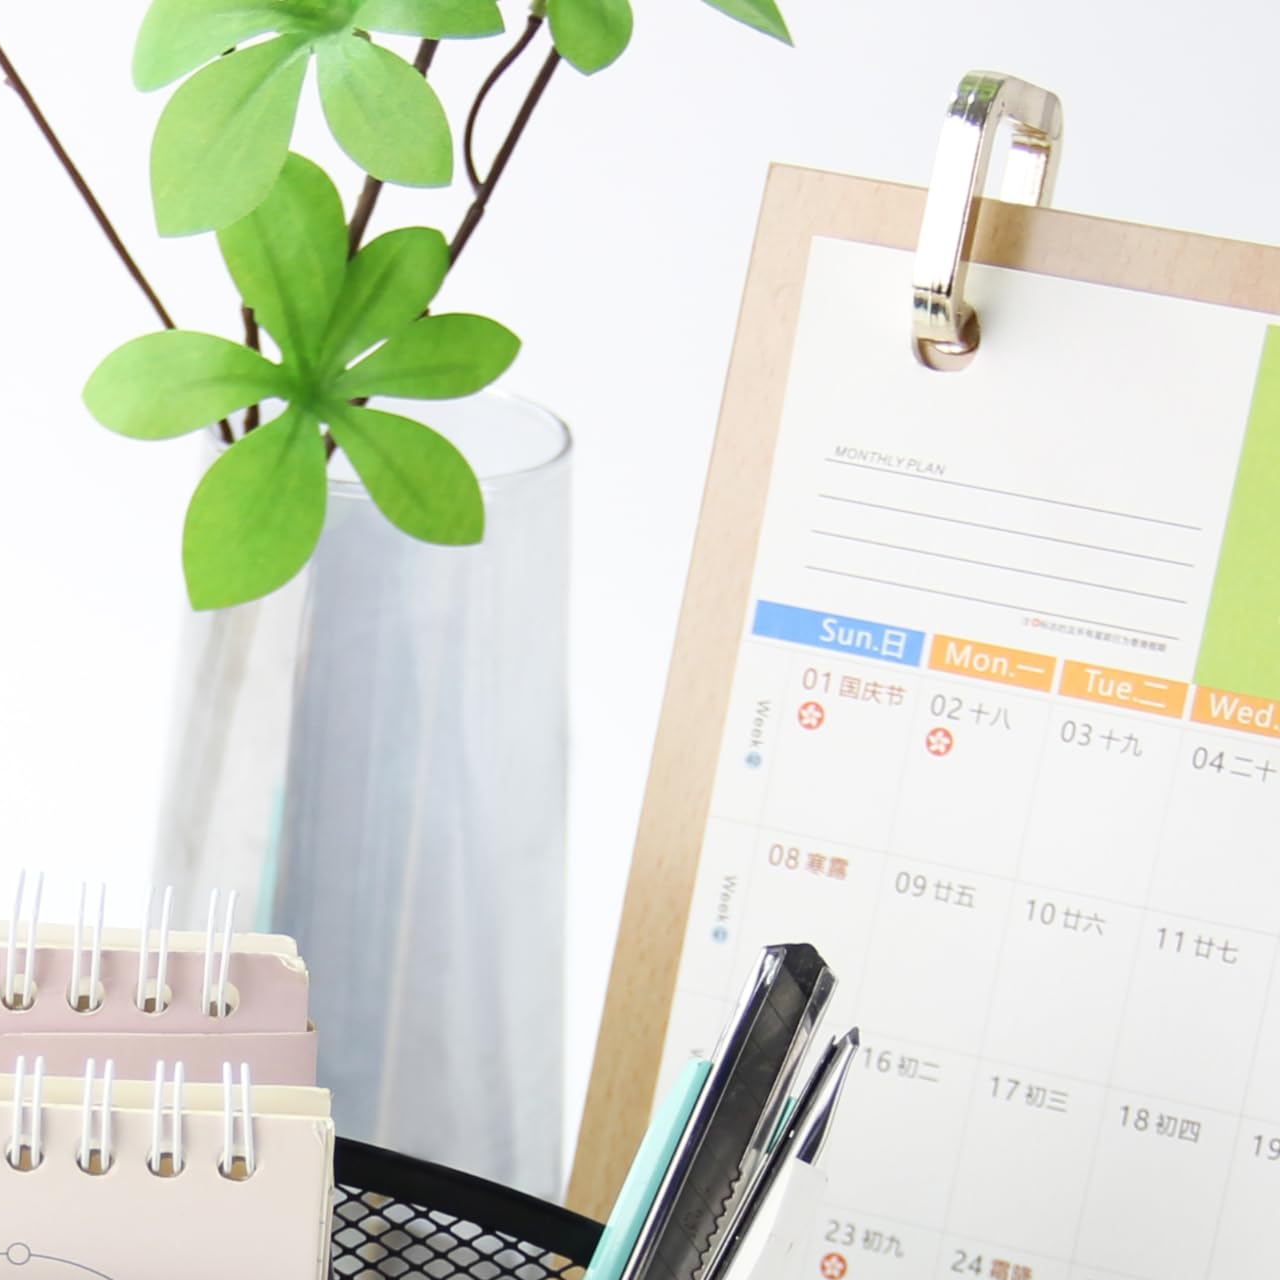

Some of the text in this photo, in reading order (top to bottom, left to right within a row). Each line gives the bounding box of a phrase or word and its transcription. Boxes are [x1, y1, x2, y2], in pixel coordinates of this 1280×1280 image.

[835, 446, 946, 476] MONTHLY PLAN
[802, 668, 908, 706] 01 国庆节
[750, 700, 771, 748] Week
[930, 693, 1011, 730] 02 十八
[1209, 693, 1280, 731] Wed.
[1060, 720, 1143, 757] 03 十九
[1191, 746, 1277, 782] 04 二十
[768, 844, 800, 871] 08
[718, 875, 737, 922] Week
[894, 871, 977, 910] 09 廿五
[1026, 899, 1106, 936] 10 廿六
[1156, 927, 1239, 965] 11 廿七
[863, 1047, 940, 1083] 16 初二
[989, 1076, 1069, 1113] 17 初三
[1118, 1105, 1201, 1144] 18 初四
[1253, 1134, 1280, 1161] 19
[824, 1219, 904, 1259] 23 初九
[951, 1250, 983, 1276] 24
